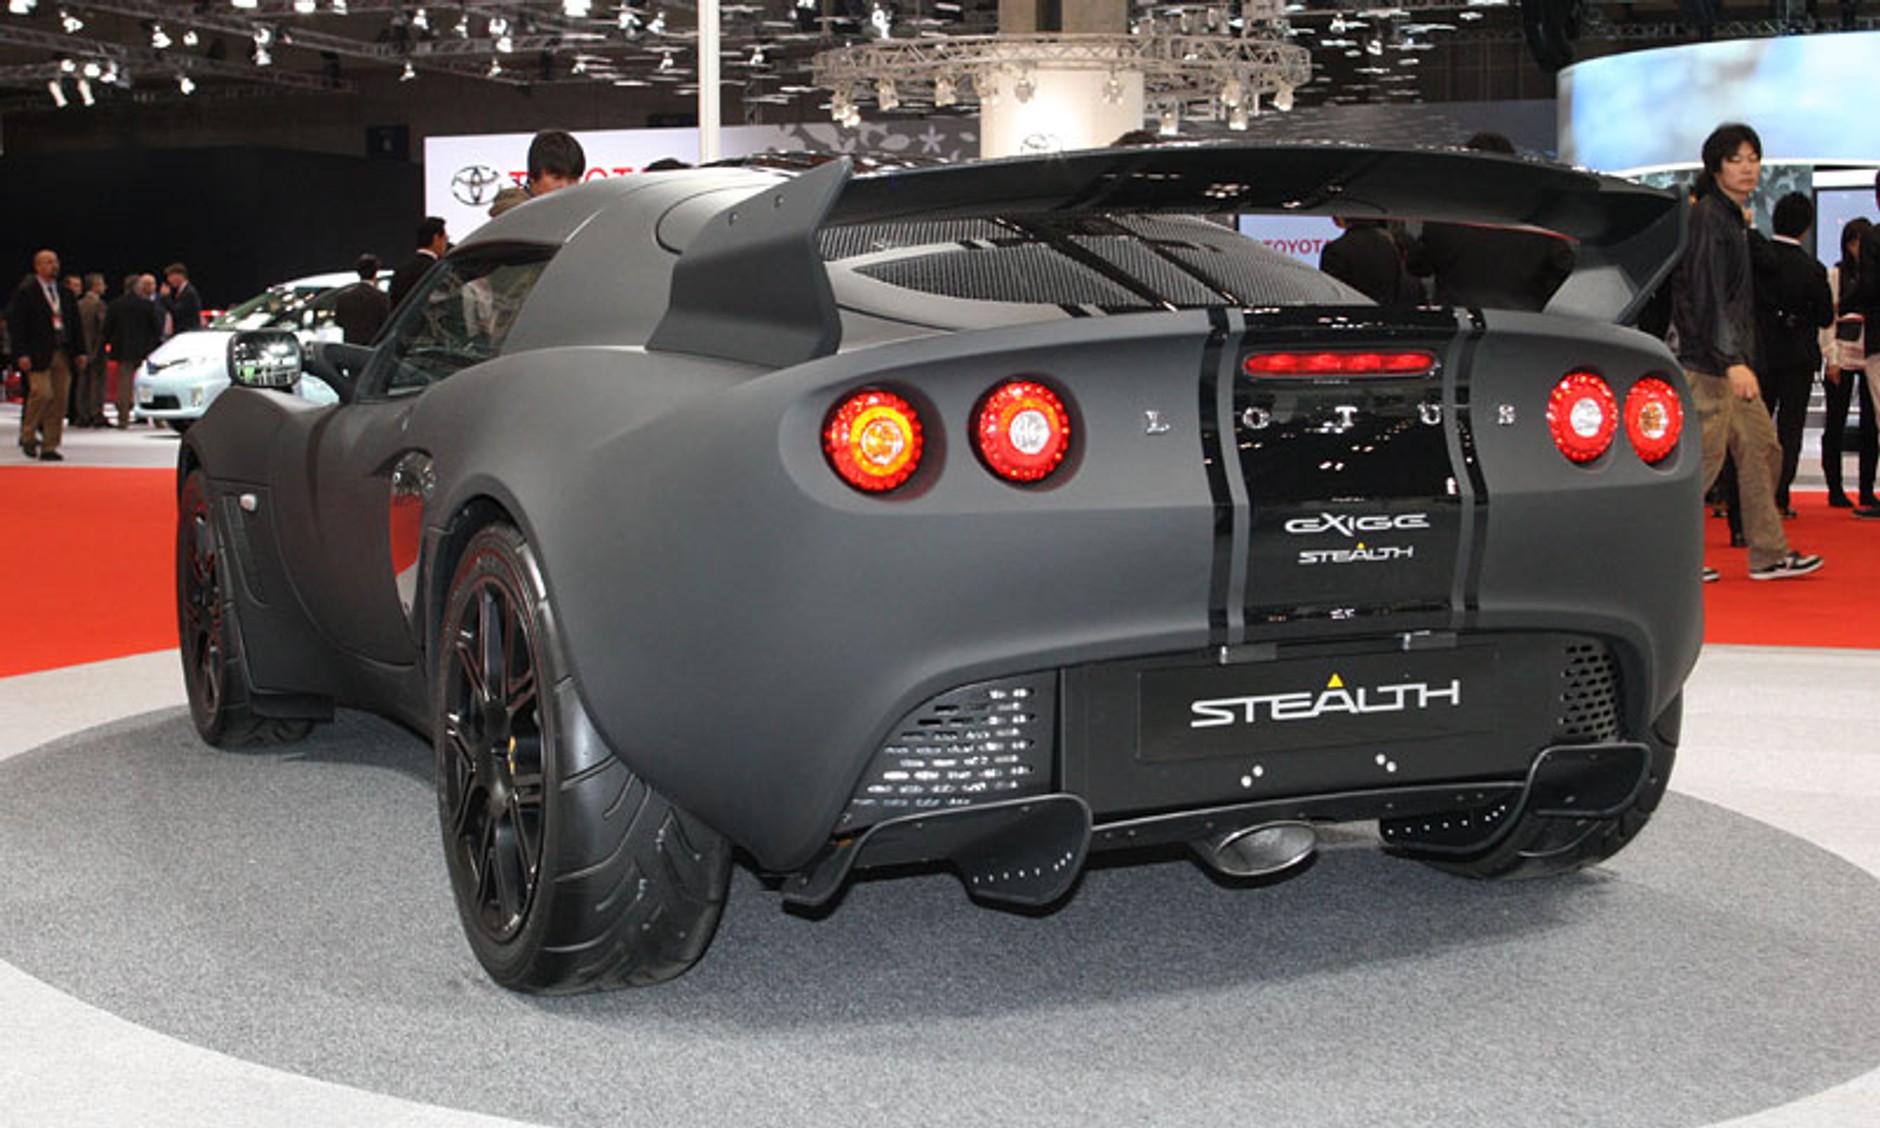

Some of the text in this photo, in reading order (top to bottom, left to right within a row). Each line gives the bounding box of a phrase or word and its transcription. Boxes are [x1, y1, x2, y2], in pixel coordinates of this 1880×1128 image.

[1146, 404, 1515, 434] LOTUS
[1297, 543, 1414, 564] STEALTH
[1190, 676, 1460, 728] STEALTH
